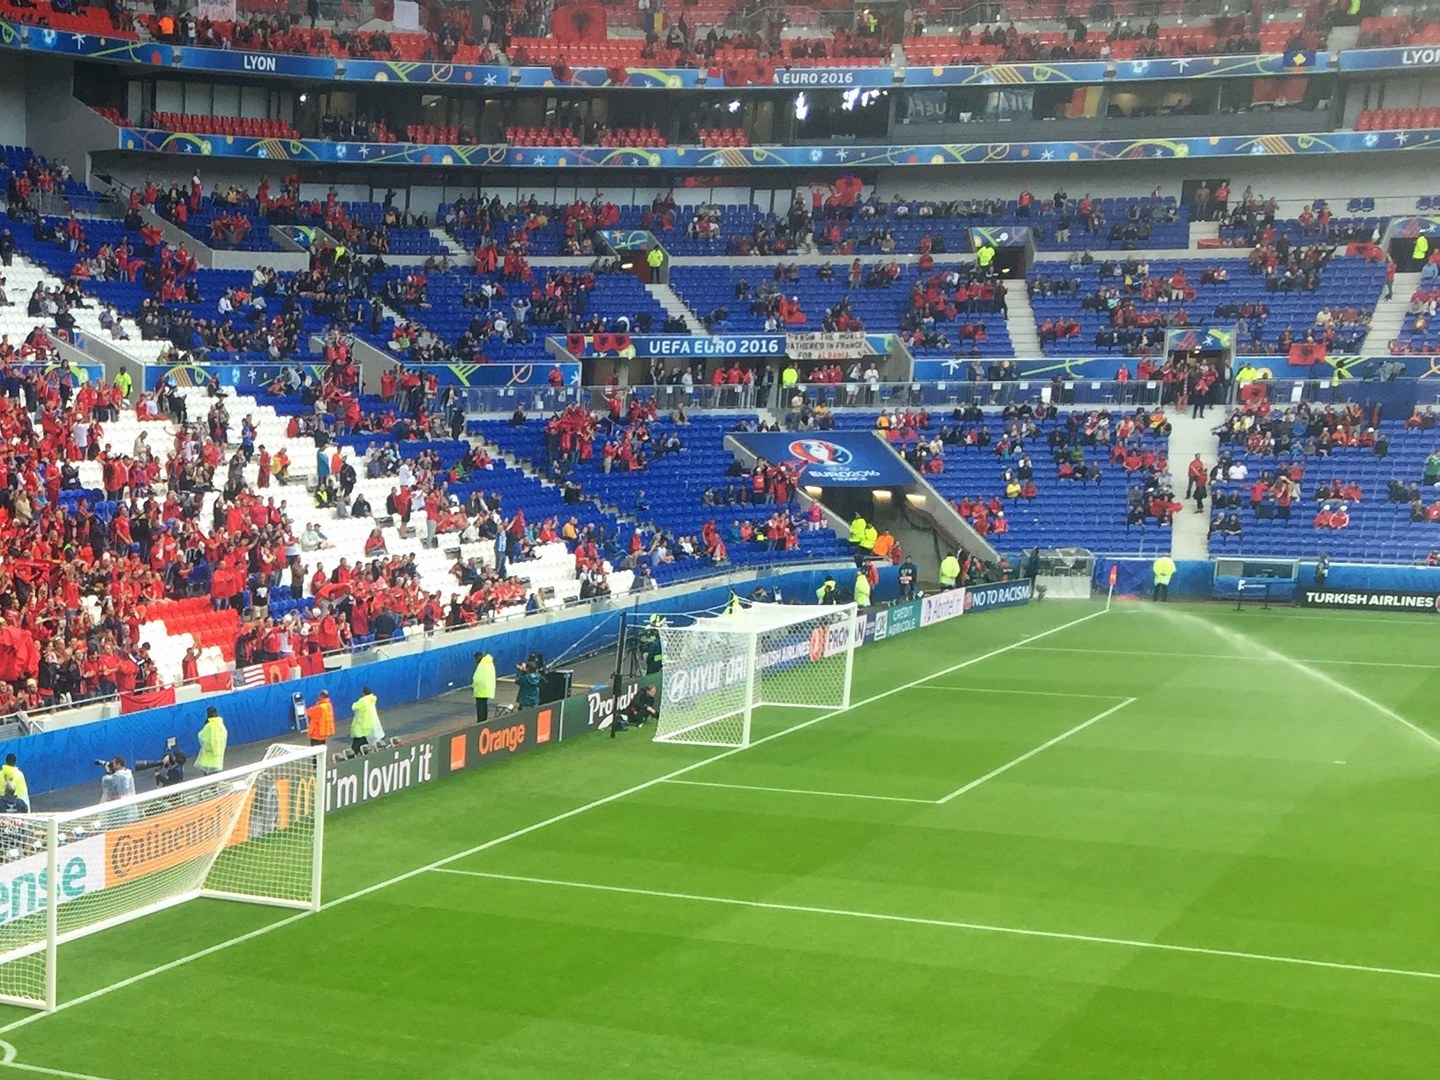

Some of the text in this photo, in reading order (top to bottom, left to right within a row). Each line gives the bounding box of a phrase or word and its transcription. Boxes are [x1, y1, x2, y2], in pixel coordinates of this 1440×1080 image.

[243, 55, 276, 71] LYON
[782, 73, 818, 84] EURO
[820, 73, 853, 84] 2016
[649, 340, 778, 354] UEFA EURO 2016
[972, 585, 1031, 606] NO TO RACISM
[1306, 592, 1434, 608] TURKISH AIRLINES
[479, 724, 525, 755] Orange
[418, 743, 434, 782] it
[111, 806, 222, 879] Continental
